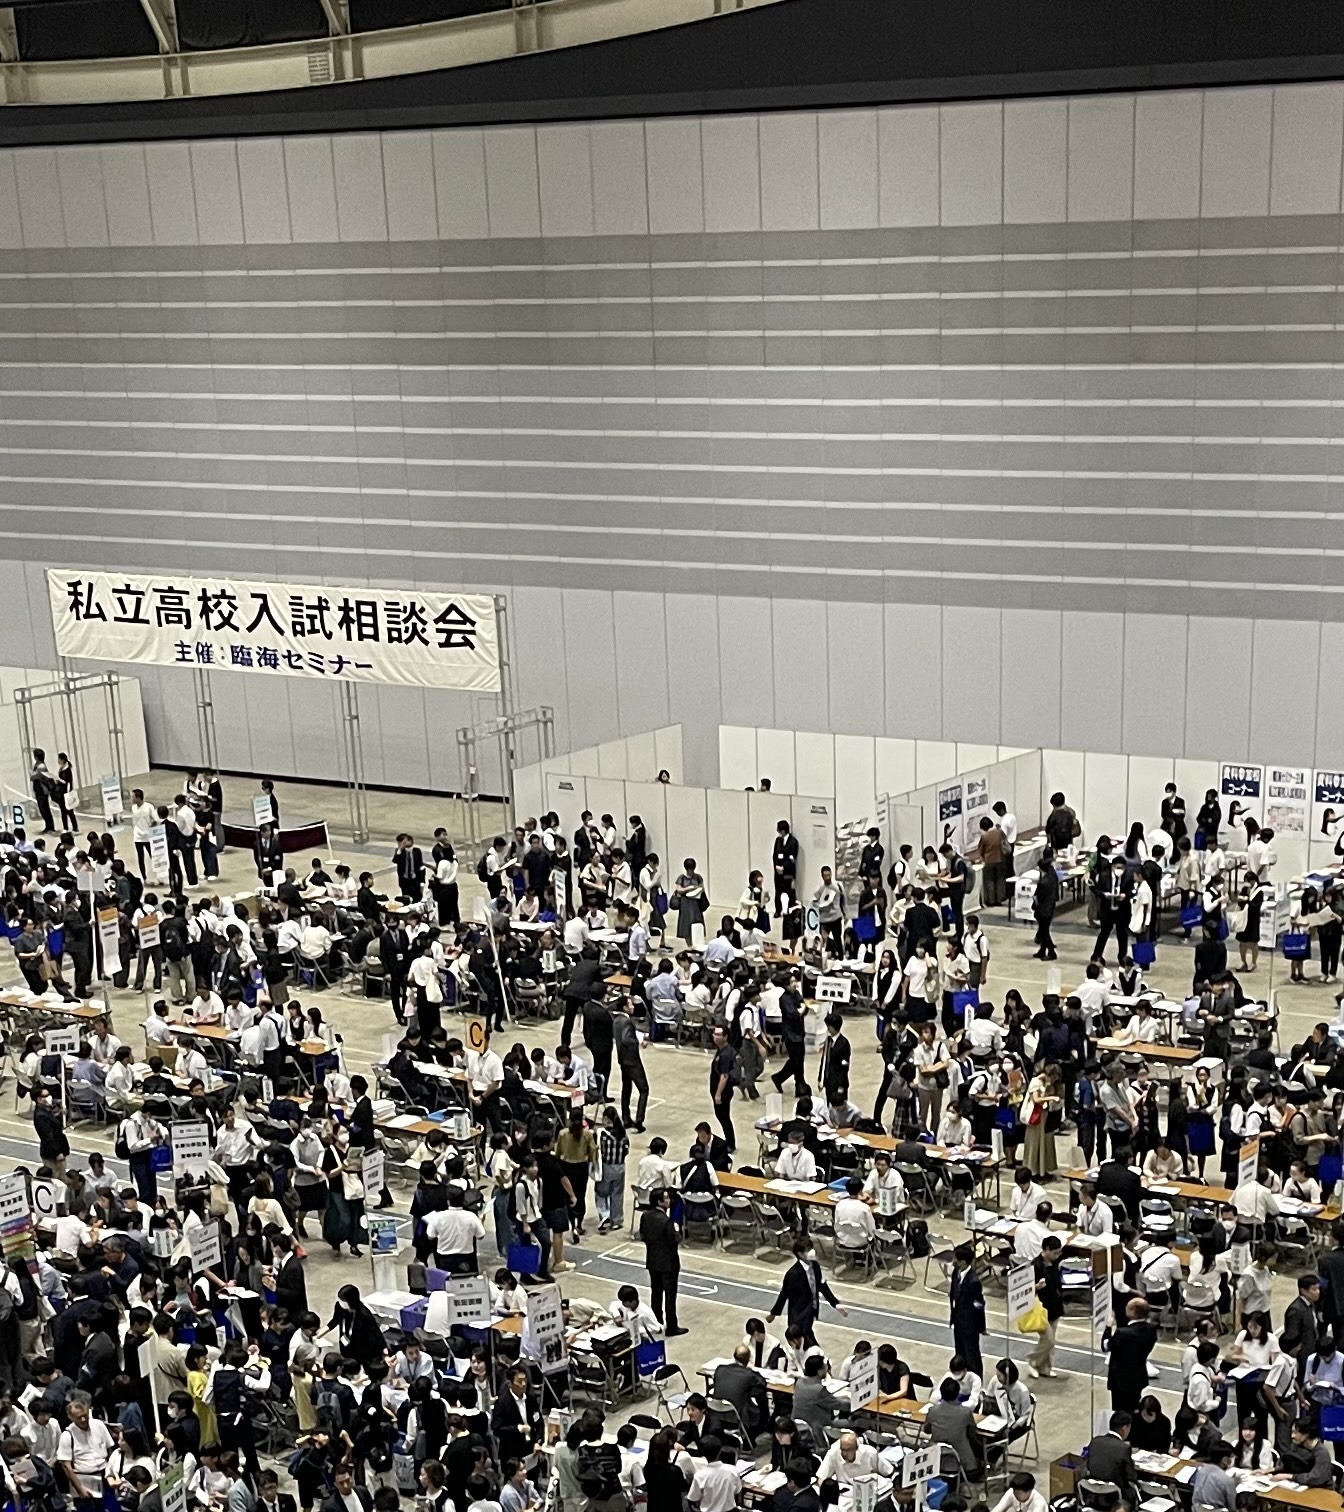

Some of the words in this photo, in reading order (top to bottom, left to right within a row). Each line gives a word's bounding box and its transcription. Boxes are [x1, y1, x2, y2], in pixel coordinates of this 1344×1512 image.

[67, 580, 477, 651] 私立高校入試相談会
[12, 806, 25, 821] B
[807, 907, 819, 931] C
[470, 1021, 483, 1047] C
[38, 1185, 55, 1215] C
